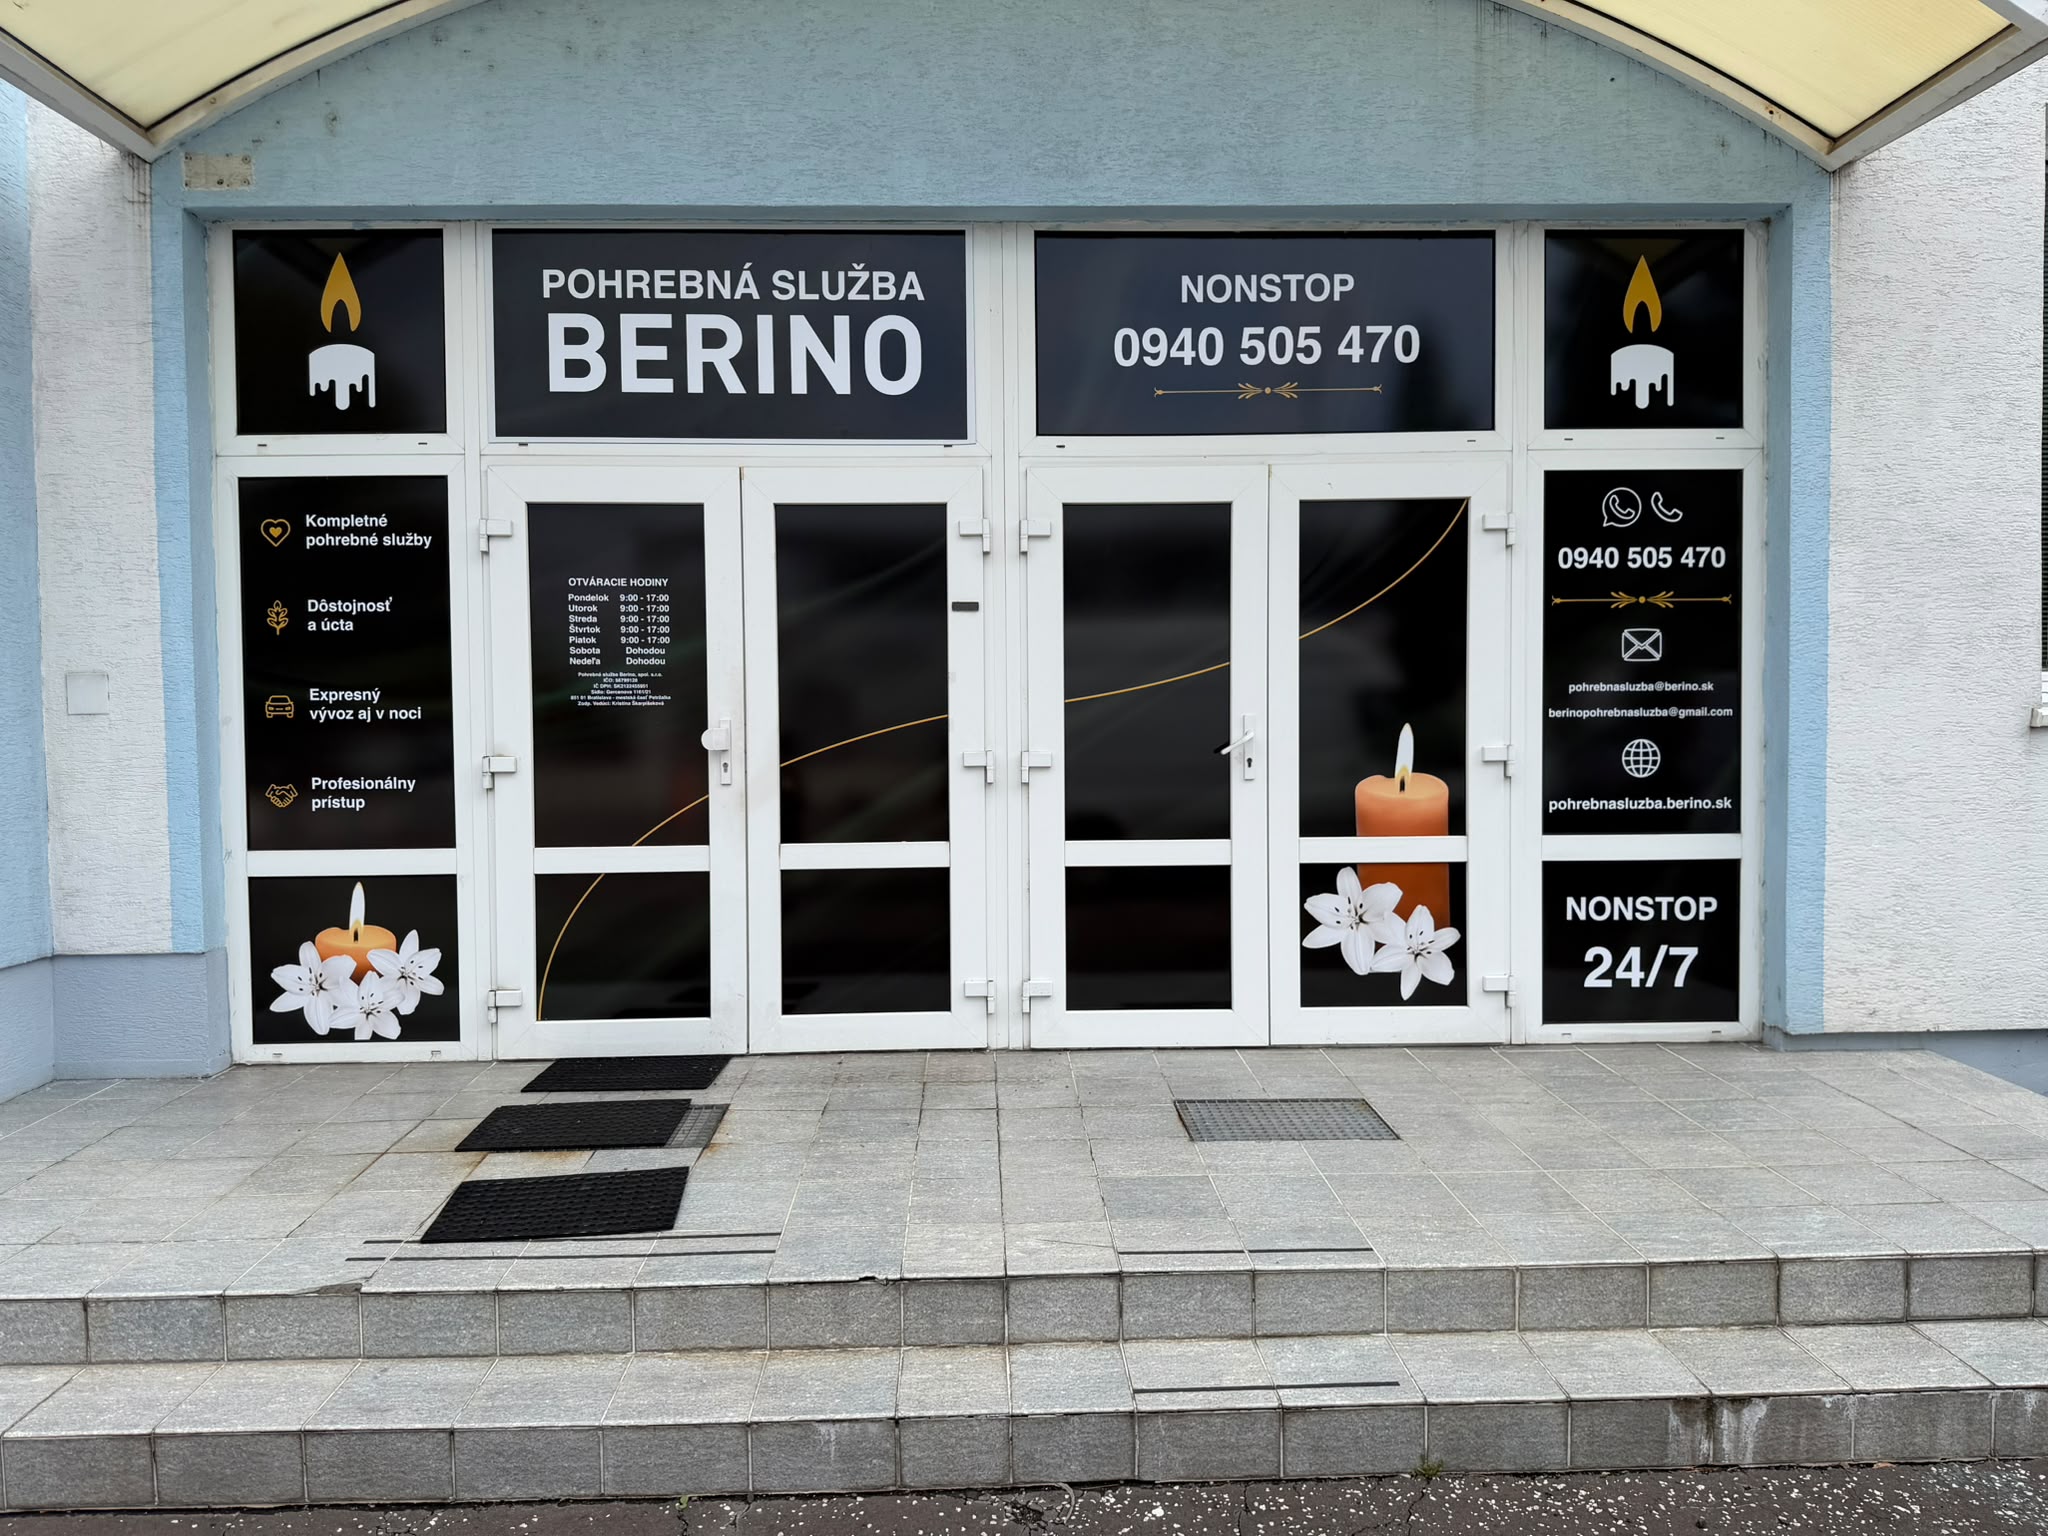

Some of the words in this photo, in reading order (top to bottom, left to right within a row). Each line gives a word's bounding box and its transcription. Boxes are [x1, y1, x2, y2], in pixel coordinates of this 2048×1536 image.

[543, 262, 760, 299] POHREBNÁ
[772, 263, 925, 300] SLUŽBA
[1182, 273, 1354, 303] NONSTOP
[1114, 327, 1224, 367] 0940
[1240, 326, 1321, 365] 505
[1338, 325, 1420, 363] 470
[548, 313, 921, 395] BERINO
[306, 514, 387, 530] Kompletné
[306, 533, 378, 549] pohrebné
[383, 533, 432, 549] služby
[1558, 547, 1619, 569] 0940
[1628, 547, 1672, 568] 505
[1681, 547, 1725, 568] 470
[568, 576, 627, 587] OTVÁRACIE
[630, 578, 669, 587] HODINY
[568, 594, 609, 602] Pondelok
[619, 594, 639, 602] 9:00
[646, 594, 669, 602] 17:00
[308, 597, 392, 615] Dôstojnosť
[568, 604, 598, 612] Utorok
[620, 604, 639, 612] 9:00
[646, 604, 670, 612] 17:00
[308, 621, 316, 631] a
[321, 618, 353, 631] úcta
[569, 615, 597, 623] Streda
[620, 615, 639, 623] 9:00
[647, 615, 670, 623] 17:00
[569, 624, 601, 633] Štvrtok
[569, 636, 597, 644] Piatok
[620, 636, 639, 644] 9:00
[647, 636, 670, 644] 17:00
[569, 647, 601, 655] Sobota
[626, 647, 665, 655] Dohodou
[569, 657, 601, 665] Nedeľa
[626, 657, 666, 665] Dohodou
[1569, 682, 1713, 693] pohrebnasluzba@berino.sk
[310, 688, 380, 704] Expresný
[310, 707, 354, 722] vývoz
[358, 707, 370, 722] aj
[376, 710, 384, 719] v
[390, 707, 421, 719] noci
[1549, 707, 1732, 719] berinopohrebnasluzba@gmail.com
[312, 776, 415, 792] Profesionálny
[312, 796, 365, 811] prístup
[1549, 797, 1731, 813] pohrebnasluzba.berino.sk
[1567, 896, 1717, 921] NONSTOP
[1584, 945, 1698, 987] 24/7
